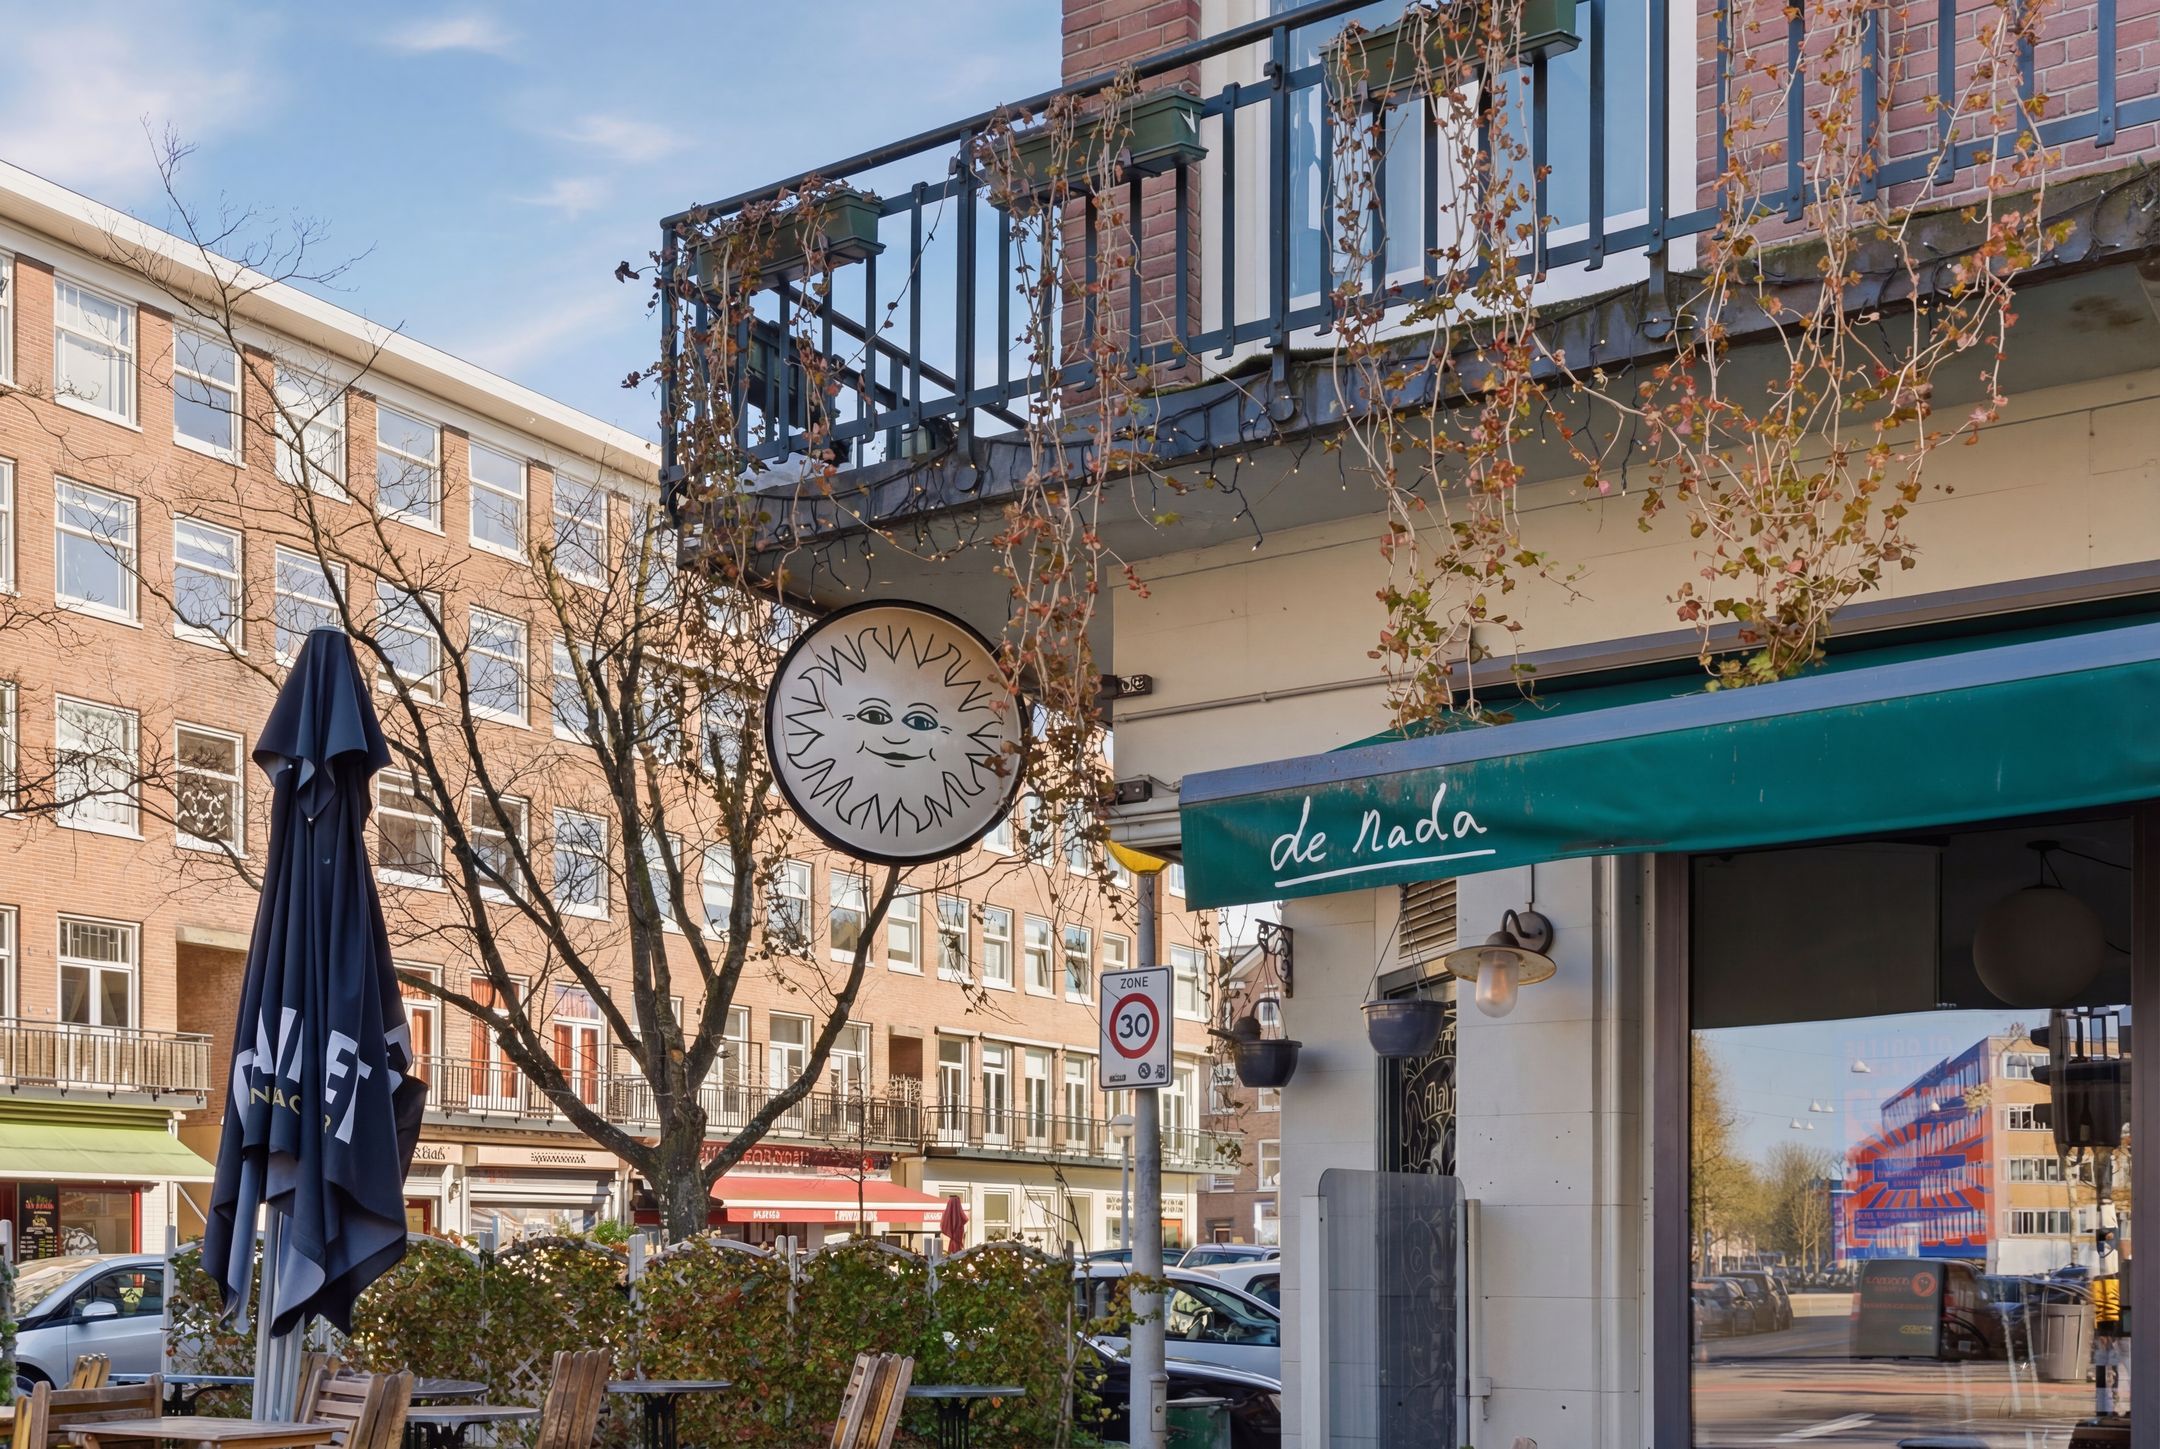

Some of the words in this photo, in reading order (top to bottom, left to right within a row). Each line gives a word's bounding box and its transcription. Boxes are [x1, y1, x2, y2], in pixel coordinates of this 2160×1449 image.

[1270, 795, 1327, 872] de
[1120, 976, 1149, 989] ZONE
[1118, 1013, 1150, 1039] 30
